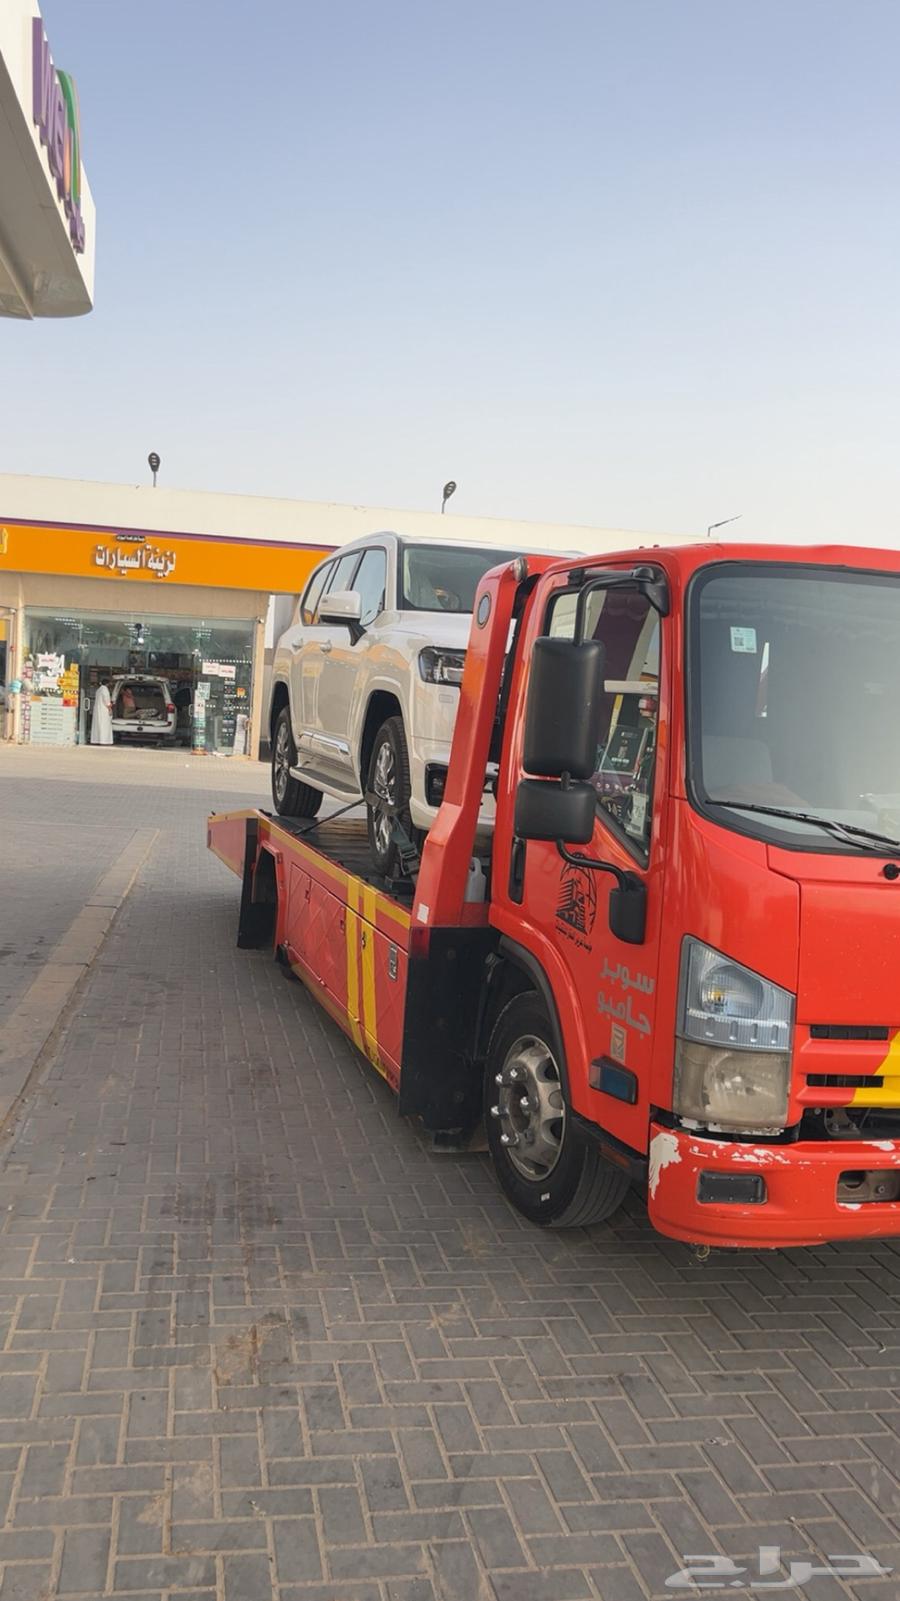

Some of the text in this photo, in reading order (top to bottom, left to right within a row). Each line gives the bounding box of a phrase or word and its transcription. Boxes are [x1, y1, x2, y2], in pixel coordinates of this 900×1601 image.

[95, 544, 146, 575] السيارات
[598, 956, 655, 994] سوبر
[597, 991, 650, 1040] جامبو
